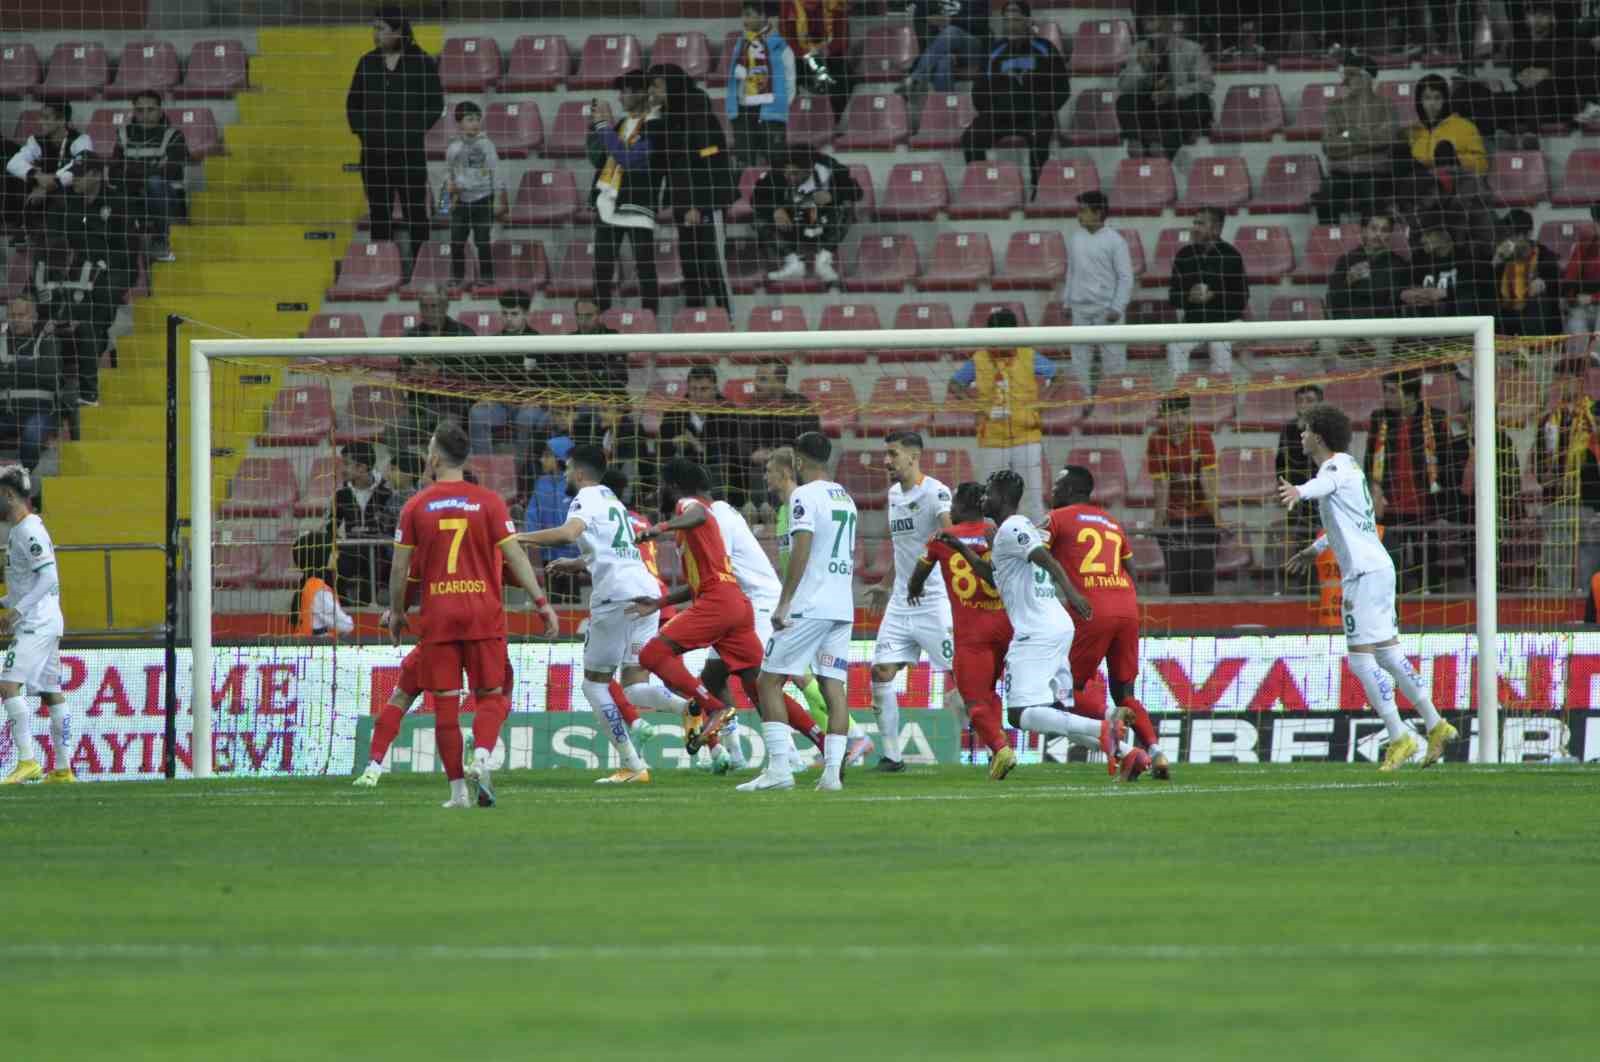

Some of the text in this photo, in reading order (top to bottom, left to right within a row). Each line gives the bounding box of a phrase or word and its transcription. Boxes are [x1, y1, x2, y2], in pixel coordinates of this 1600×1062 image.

[439, 518, 468, 574] 7
[1077, 527, 1122, 576] 27
[943, 639, 953, 658] 8
